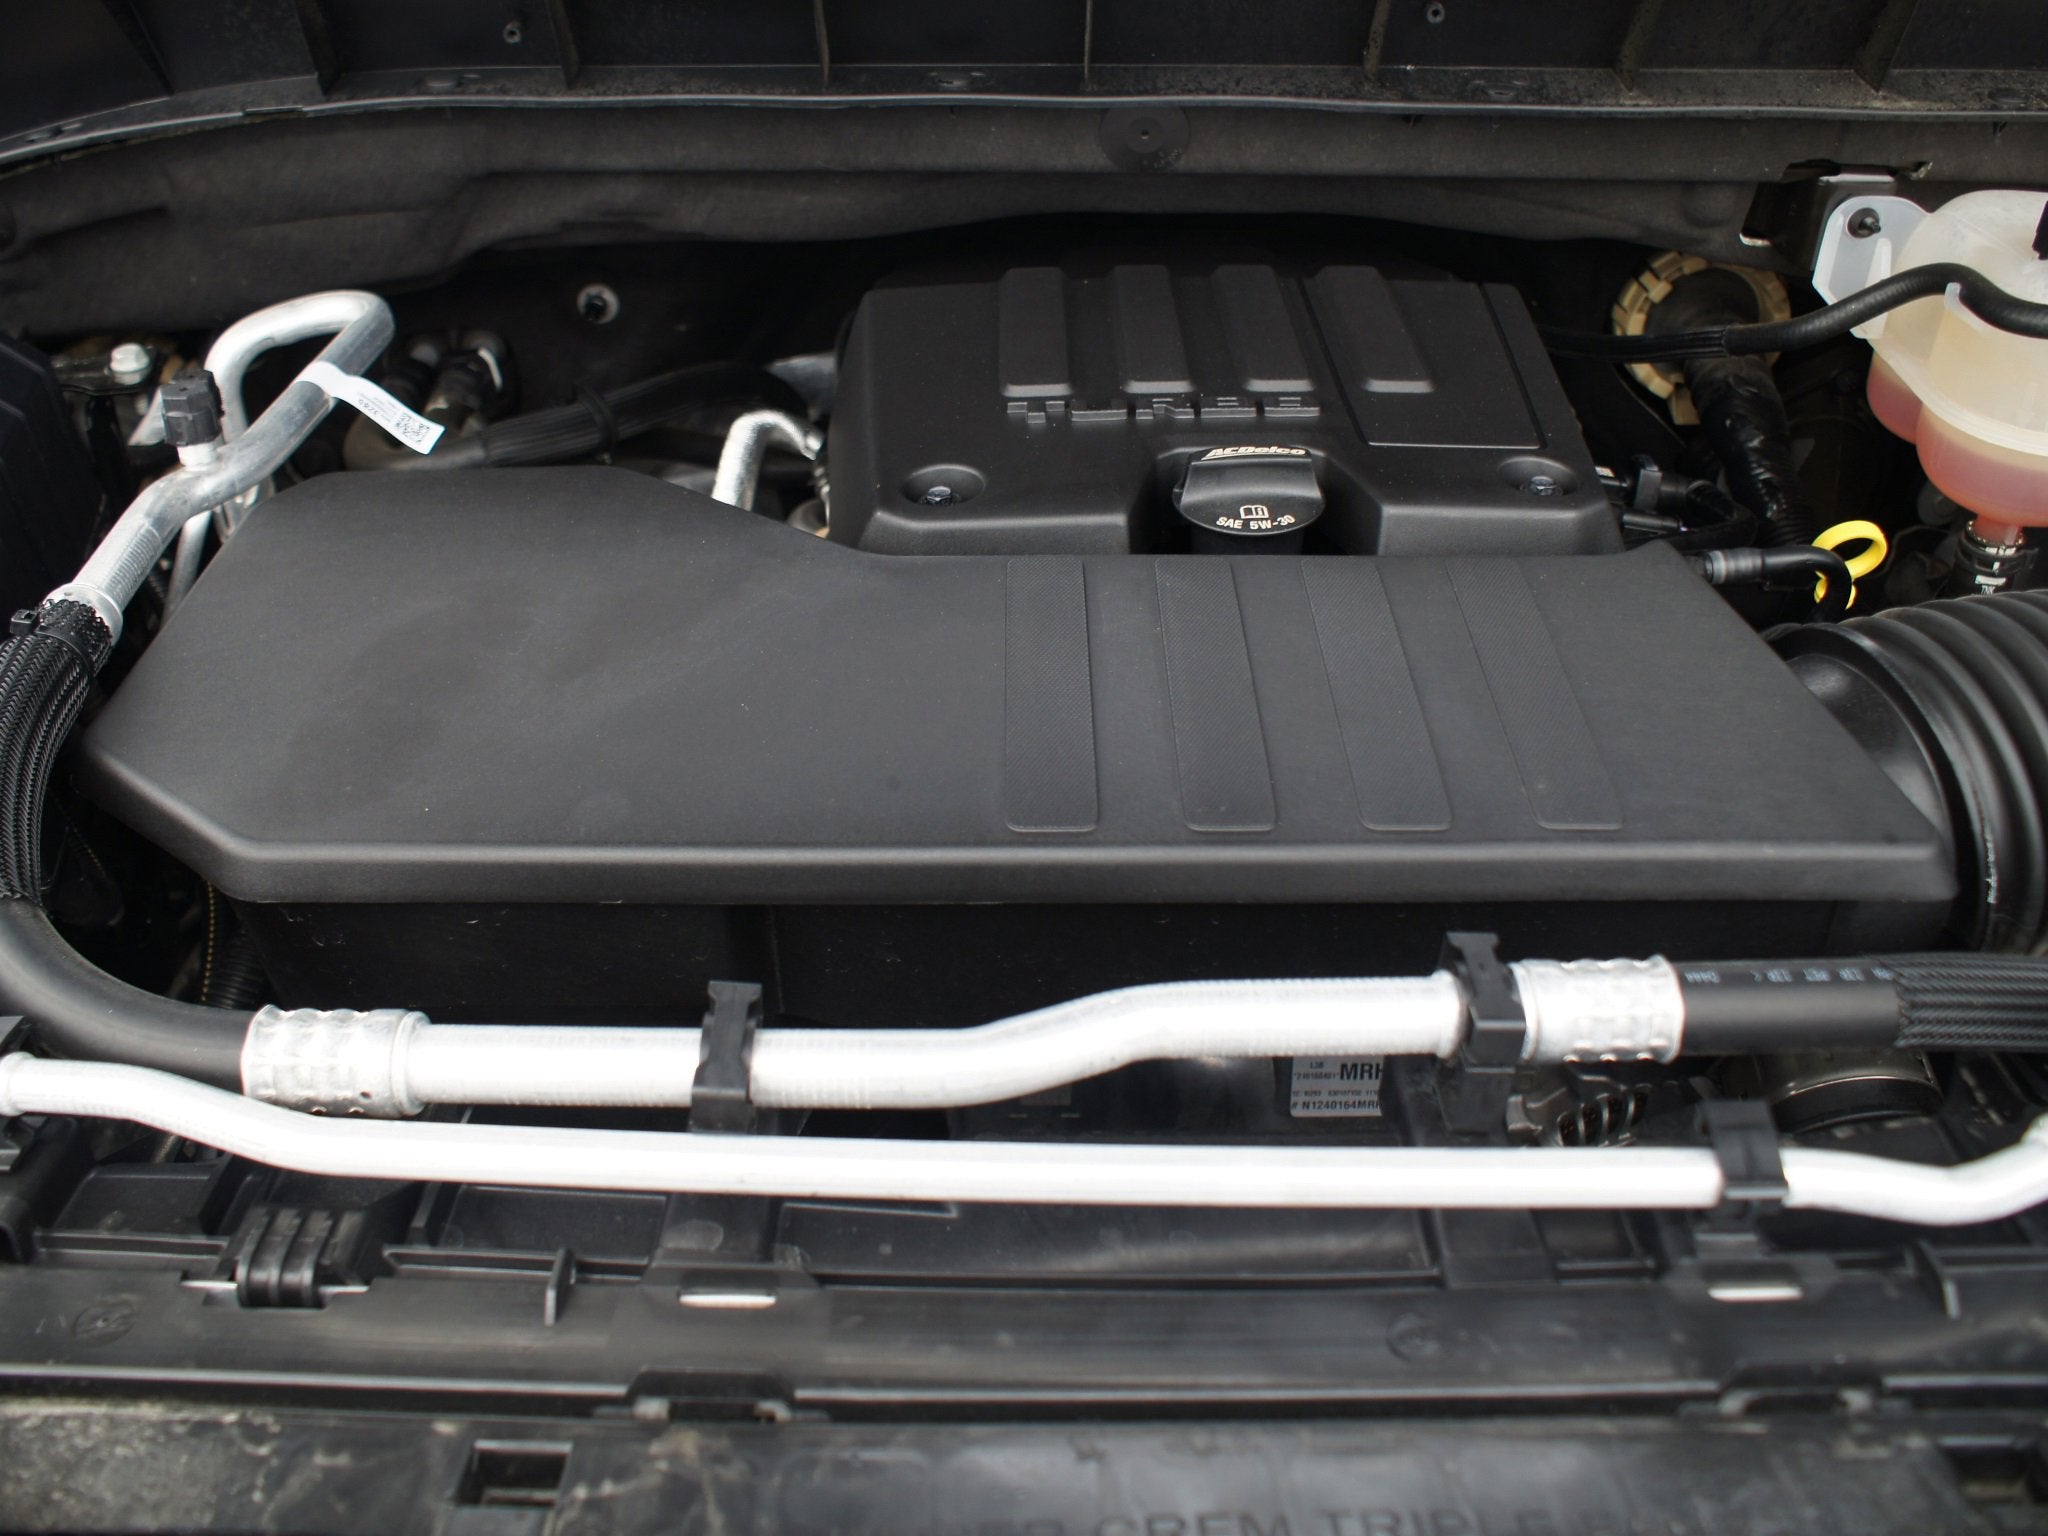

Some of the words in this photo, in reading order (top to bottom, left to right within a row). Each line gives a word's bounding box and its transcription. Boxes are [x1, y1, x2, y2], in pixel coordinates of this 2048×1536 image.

[1201, 446, 1306, 460] ACDelco
[1216, 516, 1243, 529] SAE
[1249, 515, 1296, 530] 5W-30
